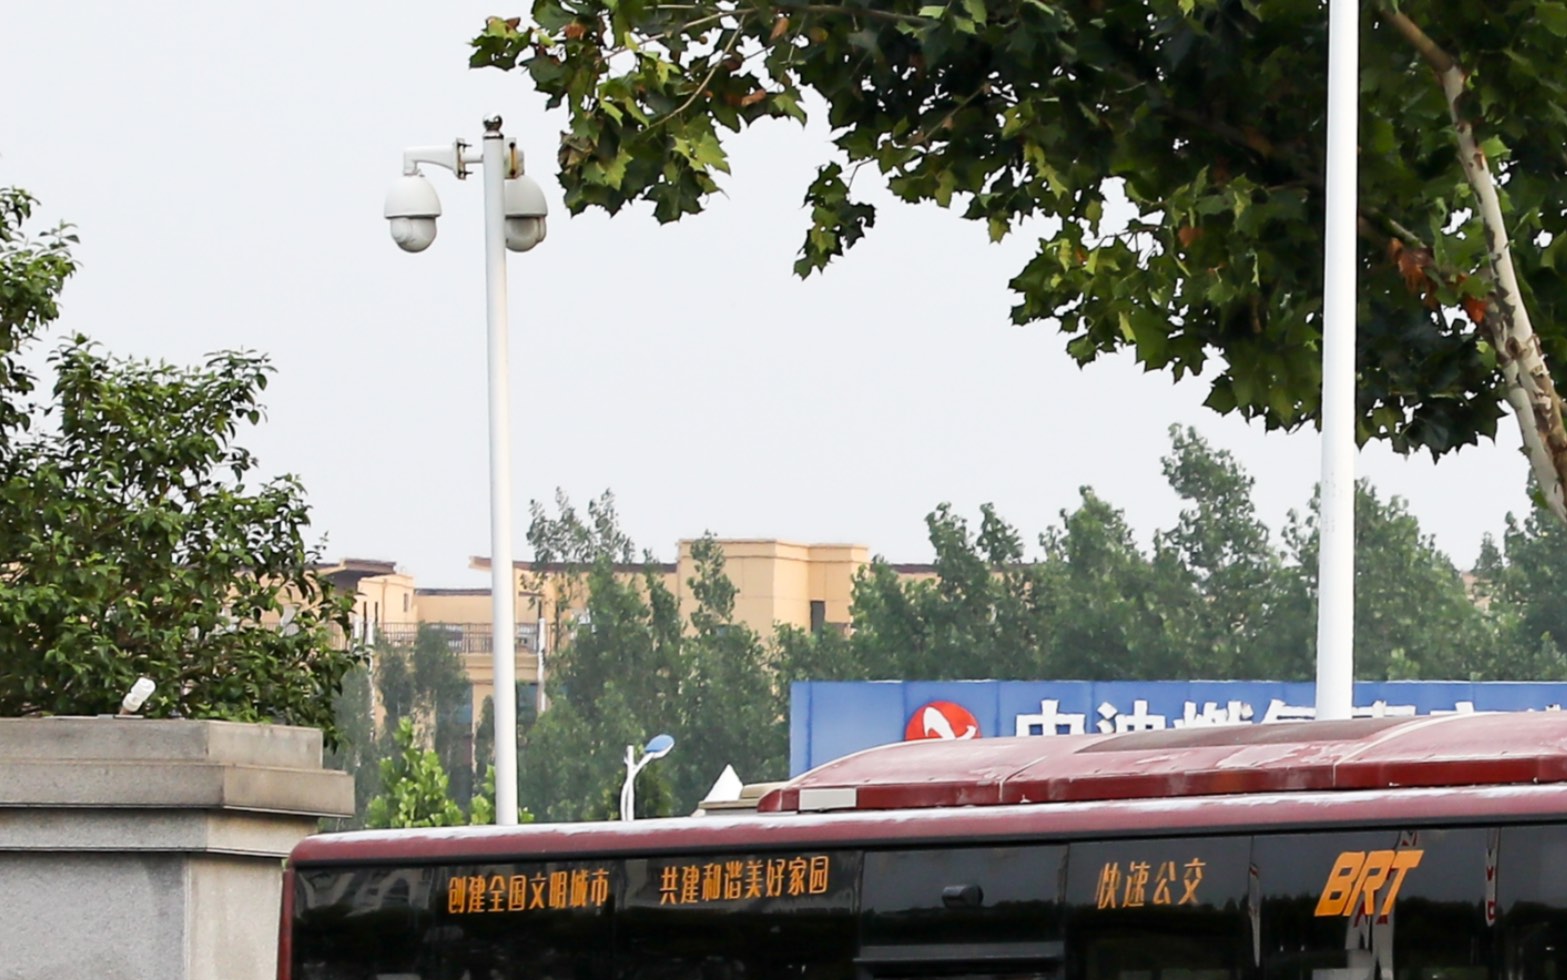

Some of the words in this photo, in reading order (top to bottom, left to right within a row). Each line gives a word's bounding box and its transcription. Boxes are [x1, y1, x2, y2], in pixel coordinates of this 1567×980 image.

[448, 869, 611, 913] 创建全国文明城市
[660, 856, 830, 905] 共建和谐美好家园
[1096, 857, 1206, 909] 快速公交
[1314, 849, 1424, 917] BRT
